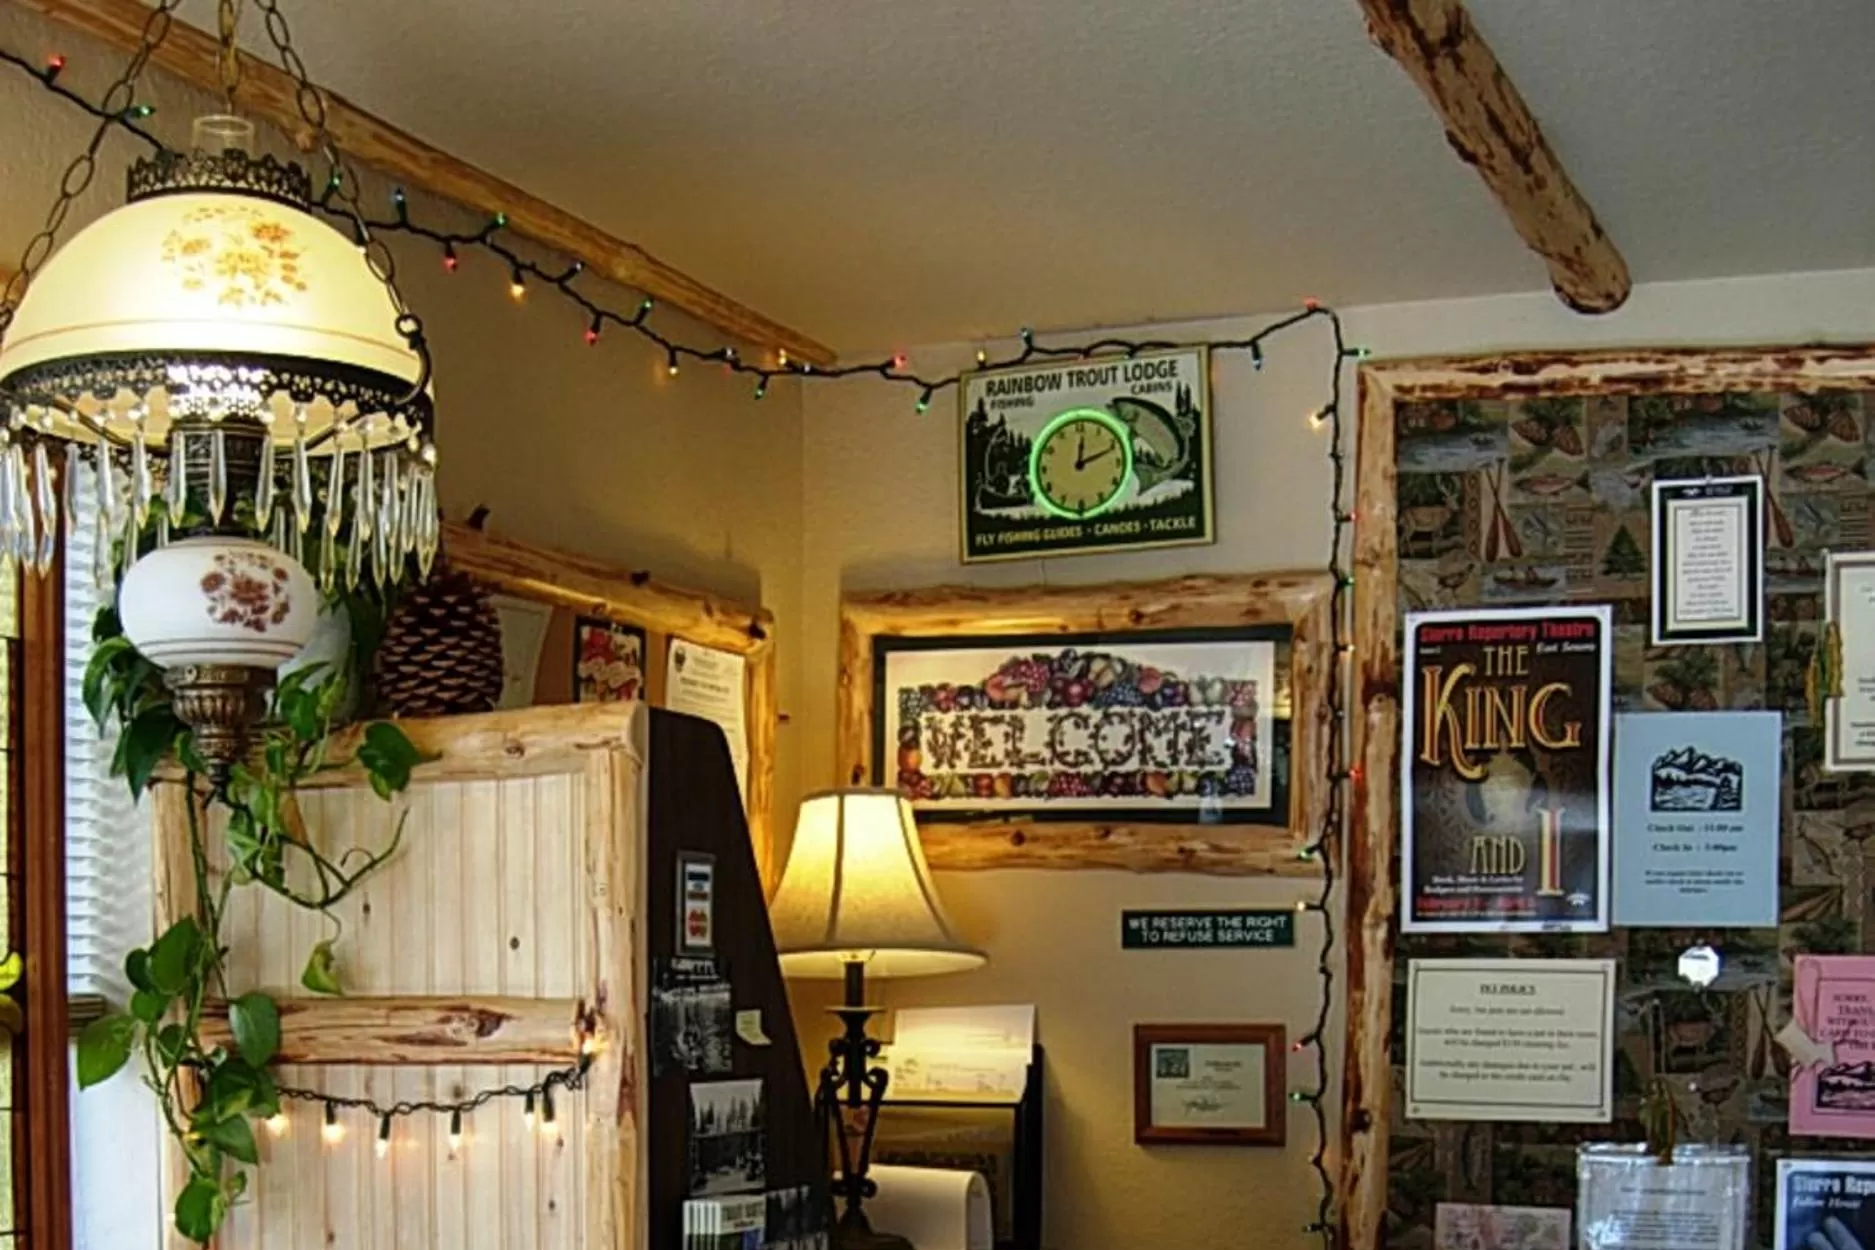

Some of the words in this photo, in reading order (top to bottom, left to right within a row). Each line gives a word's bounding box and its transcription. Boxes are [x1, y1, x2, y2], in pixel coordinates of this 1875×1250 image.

[985, 372, 1063, 397] RAINBOW
[1067, 365, 1118, 388] TROUT
[1124, 360, 1178, 382] LODGE
[1130, 381, 1172, 395] CABINS
[990, 395, 1035, 410] FISHING
[975, 533, 996, 547] FLY
[997, 529, 1041, 545] FISHING
[1043, 525, 1083, 541] GUIDES
[1150, 516, 1196, 531] TACKLE
[1484, 645, 1530, 676] THE
[1420, 663, 1582, 780] KING
[924, 708, 1225, 769] WELCOME
[1469, 835, 1525, 875] AND
[1535, 806, 1565, 897] I
[1128, 917, 1149, 929] WE
[1152, 916, 1212, 928] RESERVE
[1216, 916, 1243, 928] THE
[1246, 915, 1287, 928] RIGHT
[1141, 930, 1159, 943] TO
[1162, 930, 1213, 943] REFUSE
[1217, 929, 1274, 942] SERVICE
